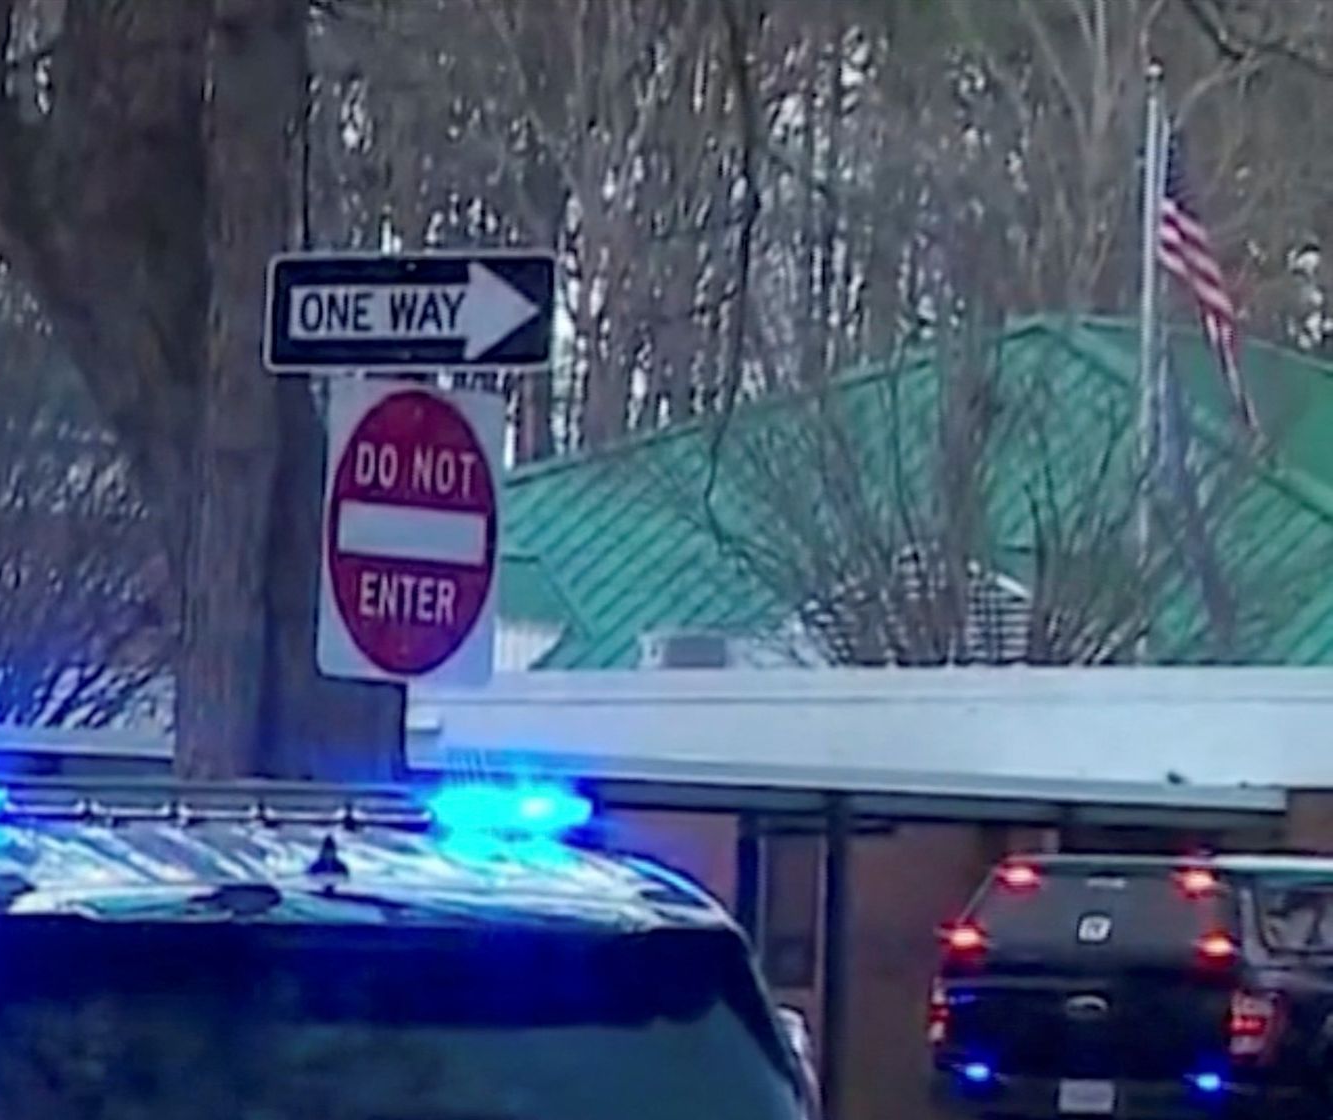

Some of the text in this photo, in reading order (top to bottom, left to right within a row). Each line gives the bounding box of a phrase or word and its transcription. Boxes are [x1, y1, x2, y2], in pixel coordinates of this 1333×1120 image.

[299, 290, 465, 332] ONE WAY
[355, 441, 478, 498] DO NOT
[359, 570, 456, 626] ENTER
